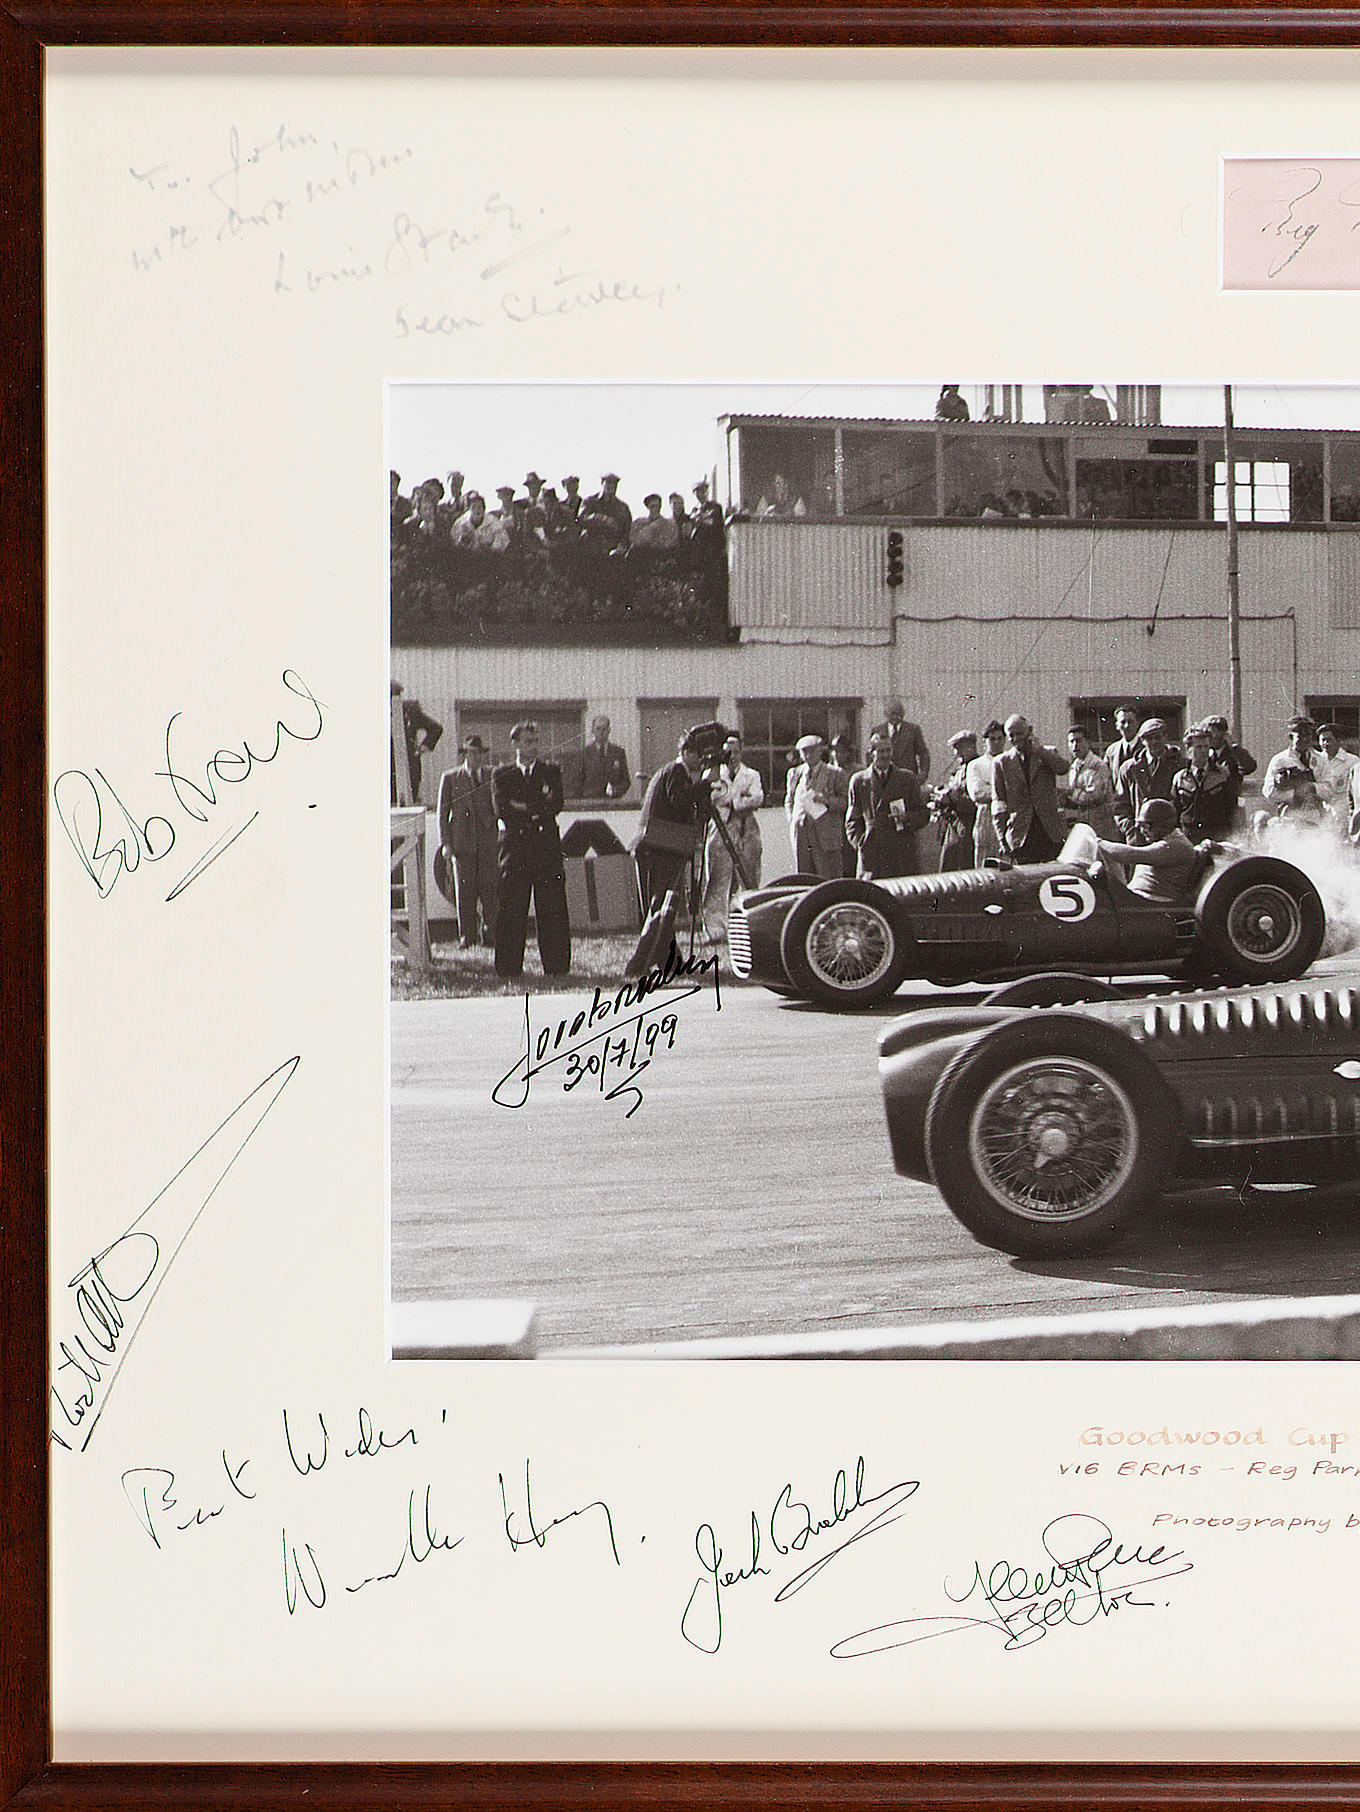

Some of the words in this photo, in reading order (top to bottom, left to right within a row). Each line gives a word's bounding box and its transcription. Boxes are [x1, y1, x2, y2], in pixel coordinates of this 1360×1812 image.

[1229, 167, 1322, 278] Reg
[1049, 877, 1085, 918] 5
[1079, 1425, 1267, 1447] Goodwood
[1288, 1428, 1349, 1454] Cup
[1117, 1461, 1202, 1477] BRMs
[1247, 1460, 1298, 1481] Reg
